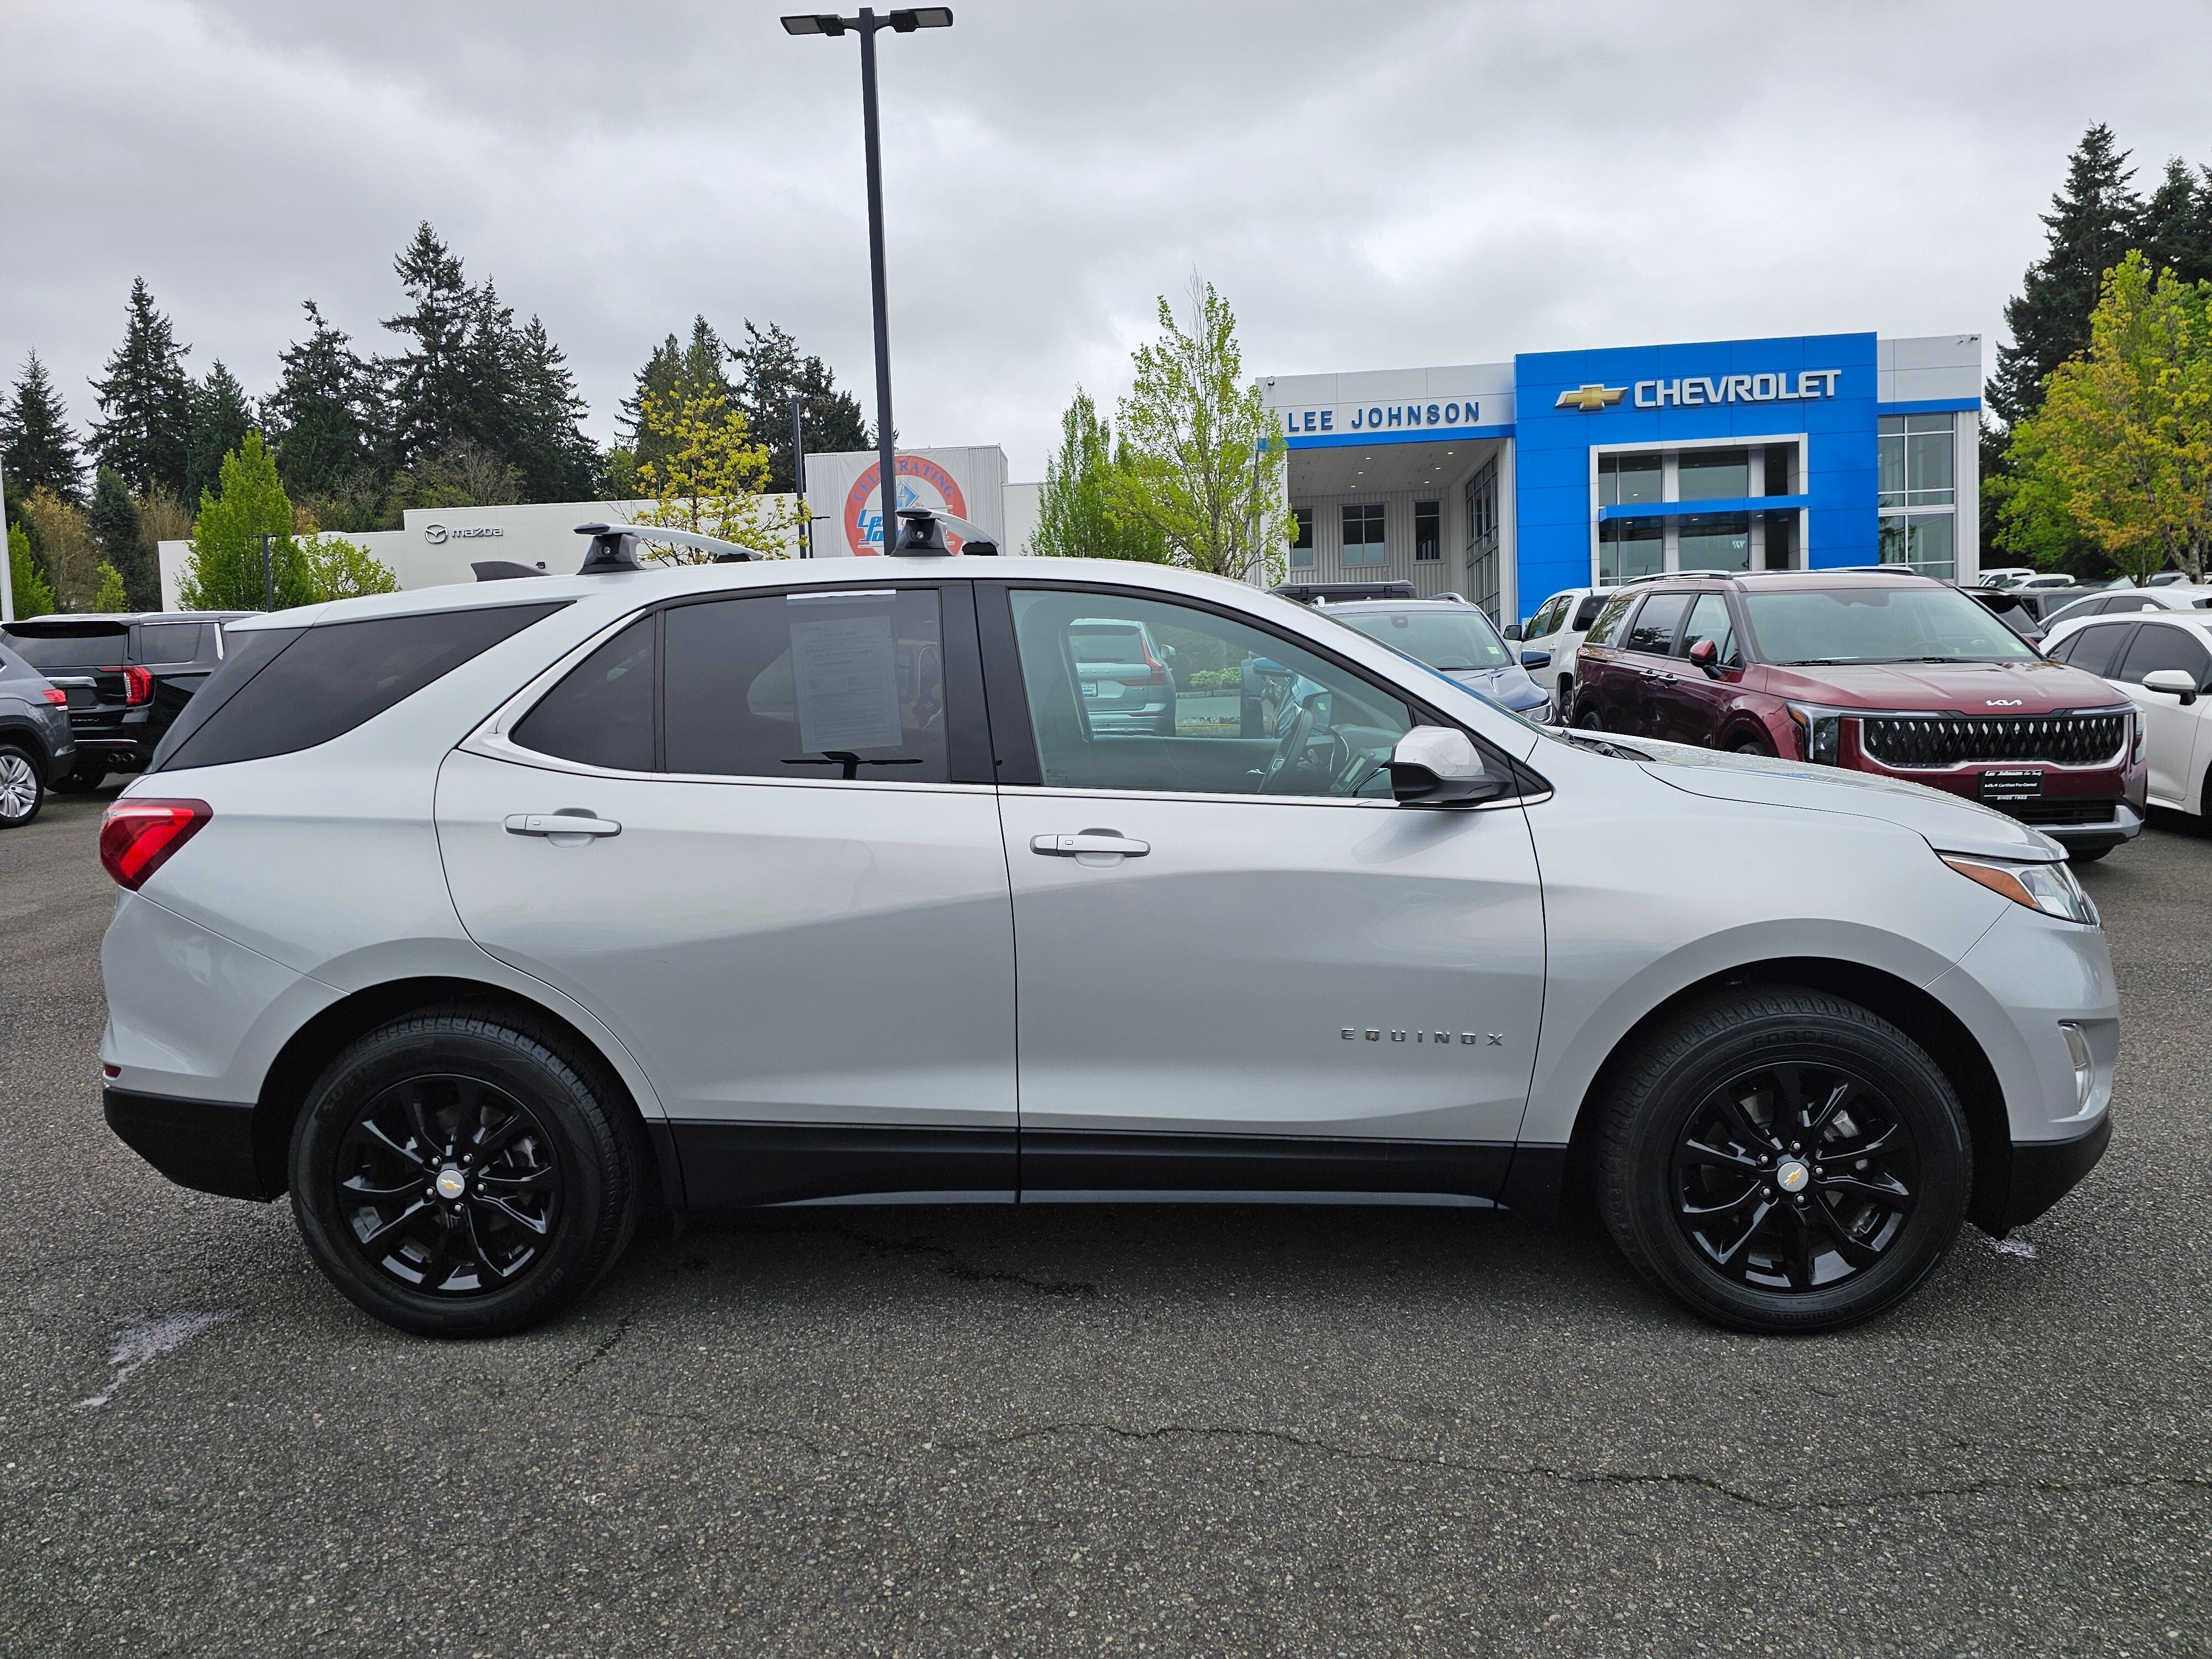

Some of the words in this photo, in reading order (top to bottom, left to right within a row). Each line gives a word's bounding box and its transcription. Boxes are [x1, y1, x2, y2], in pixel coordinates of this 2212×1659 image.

[1634, 369, 1842, 408] CHEVROLET
[1288, 410, 1333, 432] LEE
[1352, 401, 1480, 429] JOHNSON
[853, 459, 957, 502] CELRATING
[1341, 1027, 1504, 1046] EQUINOX
